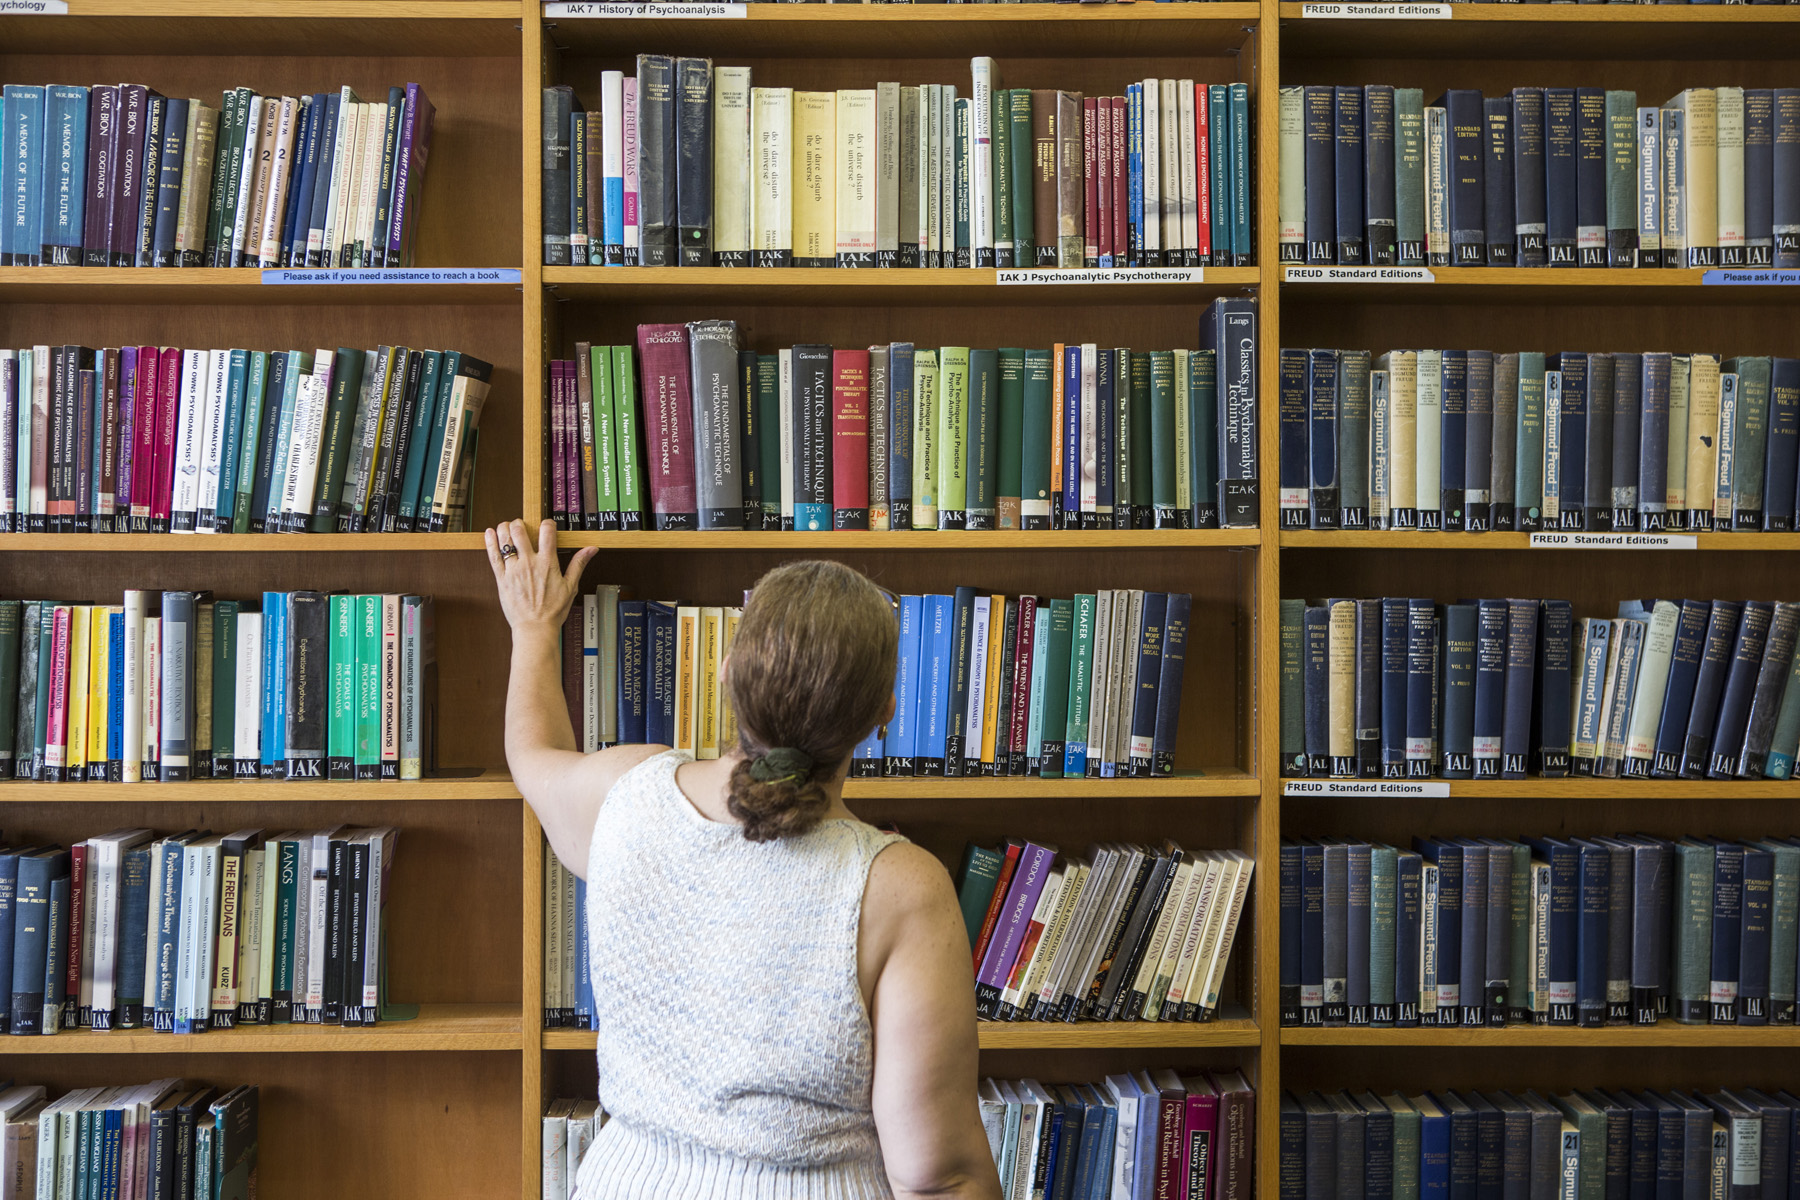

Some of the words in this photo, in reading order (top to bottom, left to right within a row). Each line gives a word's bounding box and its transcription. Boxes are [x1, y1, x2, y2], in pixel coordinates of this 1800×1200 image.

[568, 5, 586, 14] IAK
[588, 5, 593, 14] 7
[600, 5, 633, 16] History
[635, 5, 646, 14] of
[650, 5, 725, 16] Psychoanalysis
[1306, 6, 1340, 14] FREUD
[1347, 6, 1395, 15] Standard
[1399, 6, 1440, 15] Editions
[127, 112, 137, 135] BION
[627, 111, 635, 143] FREUD
[1646, 114, 1653, 128] 5
[20, 124, 28, 159] MEMOIR
[279, 149, 286, 160] 2
[19, 163, 27, 174] OF
[262, 150, 271, 162] 2
[627, 147, 635, 176] WARS
[1642, 136, 1655, 190] Sigmund
[18, 178, 26, 193] THE
[124, 149, 134, 197] COGITATIONS
[400, 169, 406, 177] IS
[16, 195, 25, 227] FUTURE
[1644, 195, 1655, 230] Freud
[1312, 242, 1332, 259] IAL
[1403, 242, 1423, 259] IAL
[1463, 246, 1479, 259] IAL
[1551, 247, 1575, 261] IAL
[1722, 248, 1742, 264] IAL
[284, 273, 313, 281] Please
[340, 274, 356, 282] you
[358, 272, 380, 280] need
[1000, 273, 1020, 282] IAK
[1023, 273, 1028, 282] J
[1032, 273, 1110, 283] Psychoanalytic
[1113, 272, 1191, 282] Psychotherapy
[1288, 270, 1323, 278] FREUD
[1329, 270, 1377, 278] Standard
[1380, 270, 1423, 279] Editions
[1724, 274, 1752, 282] Please
[1780, 275, 1794, 283] you
[1230, 317, 1249, 325] Langs
[1100, 353, 1108, 386] HAYNAL
[1240, 338, 1252, 385] Classics
[166, 359, 176, 397] Introducing
[876, 366, 885, 410] TACTICS
[1376, 376, 1383, 391] 7
[1725, 379, 1732, 392] 9
[815, 371, 825, 417] TACTICS
[1242, 388, 1248, 396] in
[712, 373, 721, 442] PSYCHOANALYTIC
[877, 412, 885, 430] and
[1229, 384, 1241, 443] Technique
[164, 398, 174, 446] Psychoanalysis
[185, 396, 195, 462] PSYCHOANALYSIS?
[582, 402, 592, 444] BETWEEN
[723, 400, 731, 462] FUNDAMENTALS
[815, 418, 824, 435] and
[1374, 399, 1386, 453] Sigmund
[1548, 399, 1559, 449] Sigmund
[1721, 400, 1734, 449] Sigmund
[1240, 398, 1253, 479] Psychoanalyti
[584, 446, 593, 472] SKINS
[714, 442, 723, 486] TECHNIQUE
[724, 464, 731, 474] OF
[876, 432, 885, 502] TECHNIQUES
[1548, 454, 1558, 484] Freud
[1720, 453, 1731, 486] Freud
[624, 464, 632, 496] Synthesis
[954, 469, 960, 479] of
[1376, 457, 1386, 492] Freud
[1286, 510, 1307, 525] IAL
[1394, 510, 1414, 526] IAL
[1561, 512, 1582, 528] IAL
[1575, 536, 1623, 544] Standard
[1626, 536, 1669, 544] Editions
[624, 627, 632, 637] OF
[1080, 598, 1089, 639] SCHAFER
[1592, 624, 1606, 639] 12
[624, 640, 632, 701] ABNORMALITY
[1587, 647, 1601, 701] Sigmund
[1582, 703, 1595, 739] Freud
[288, 760, 321, 777] IAK
[886, 758, 912, 768] IAK
[1333, 758, 1354, 774] IAL
[1447, 756, 1471, 770] IAL
[1329, 784, 1377, 792] Standard
[1380, 784, 1423, 792] Editions
[164, 852, 178, 906] Psychoanalytic
[226, 860, 237, 878] THE
[283, 846, 294, 885] LANGS
[162, 906, 175, 934] Theory
[223, 880, 235, 937] FREUDIANS
[1011, 894, 1028, 924] BRIDGES
[1184, 872, 1217, 960] TRANSFORMATIONS
[1219, 871, 1249, 960] TRANSFORMATIONS
[1425, 893, 1436, 940] Sigmund
[1537, 893, 1549, 943] Sigmund
[161, 943, 172, 973] George
[1426, 944, 1435, 975] Freud
[1538, 946, 1548, 979] Freud
[154, 1013, 173, 1030] IAK
[344, 1006, 361, 1020] IAK
[1349, 1007, 1369, 1023] IAL
[1554, 1005, 1574, 1020] IAL
[1191, 1135, 1201, 1169] Theory
[1565, 1135, 1578, 1150] 21
[1714, 1133, 1727, 1148] 22
